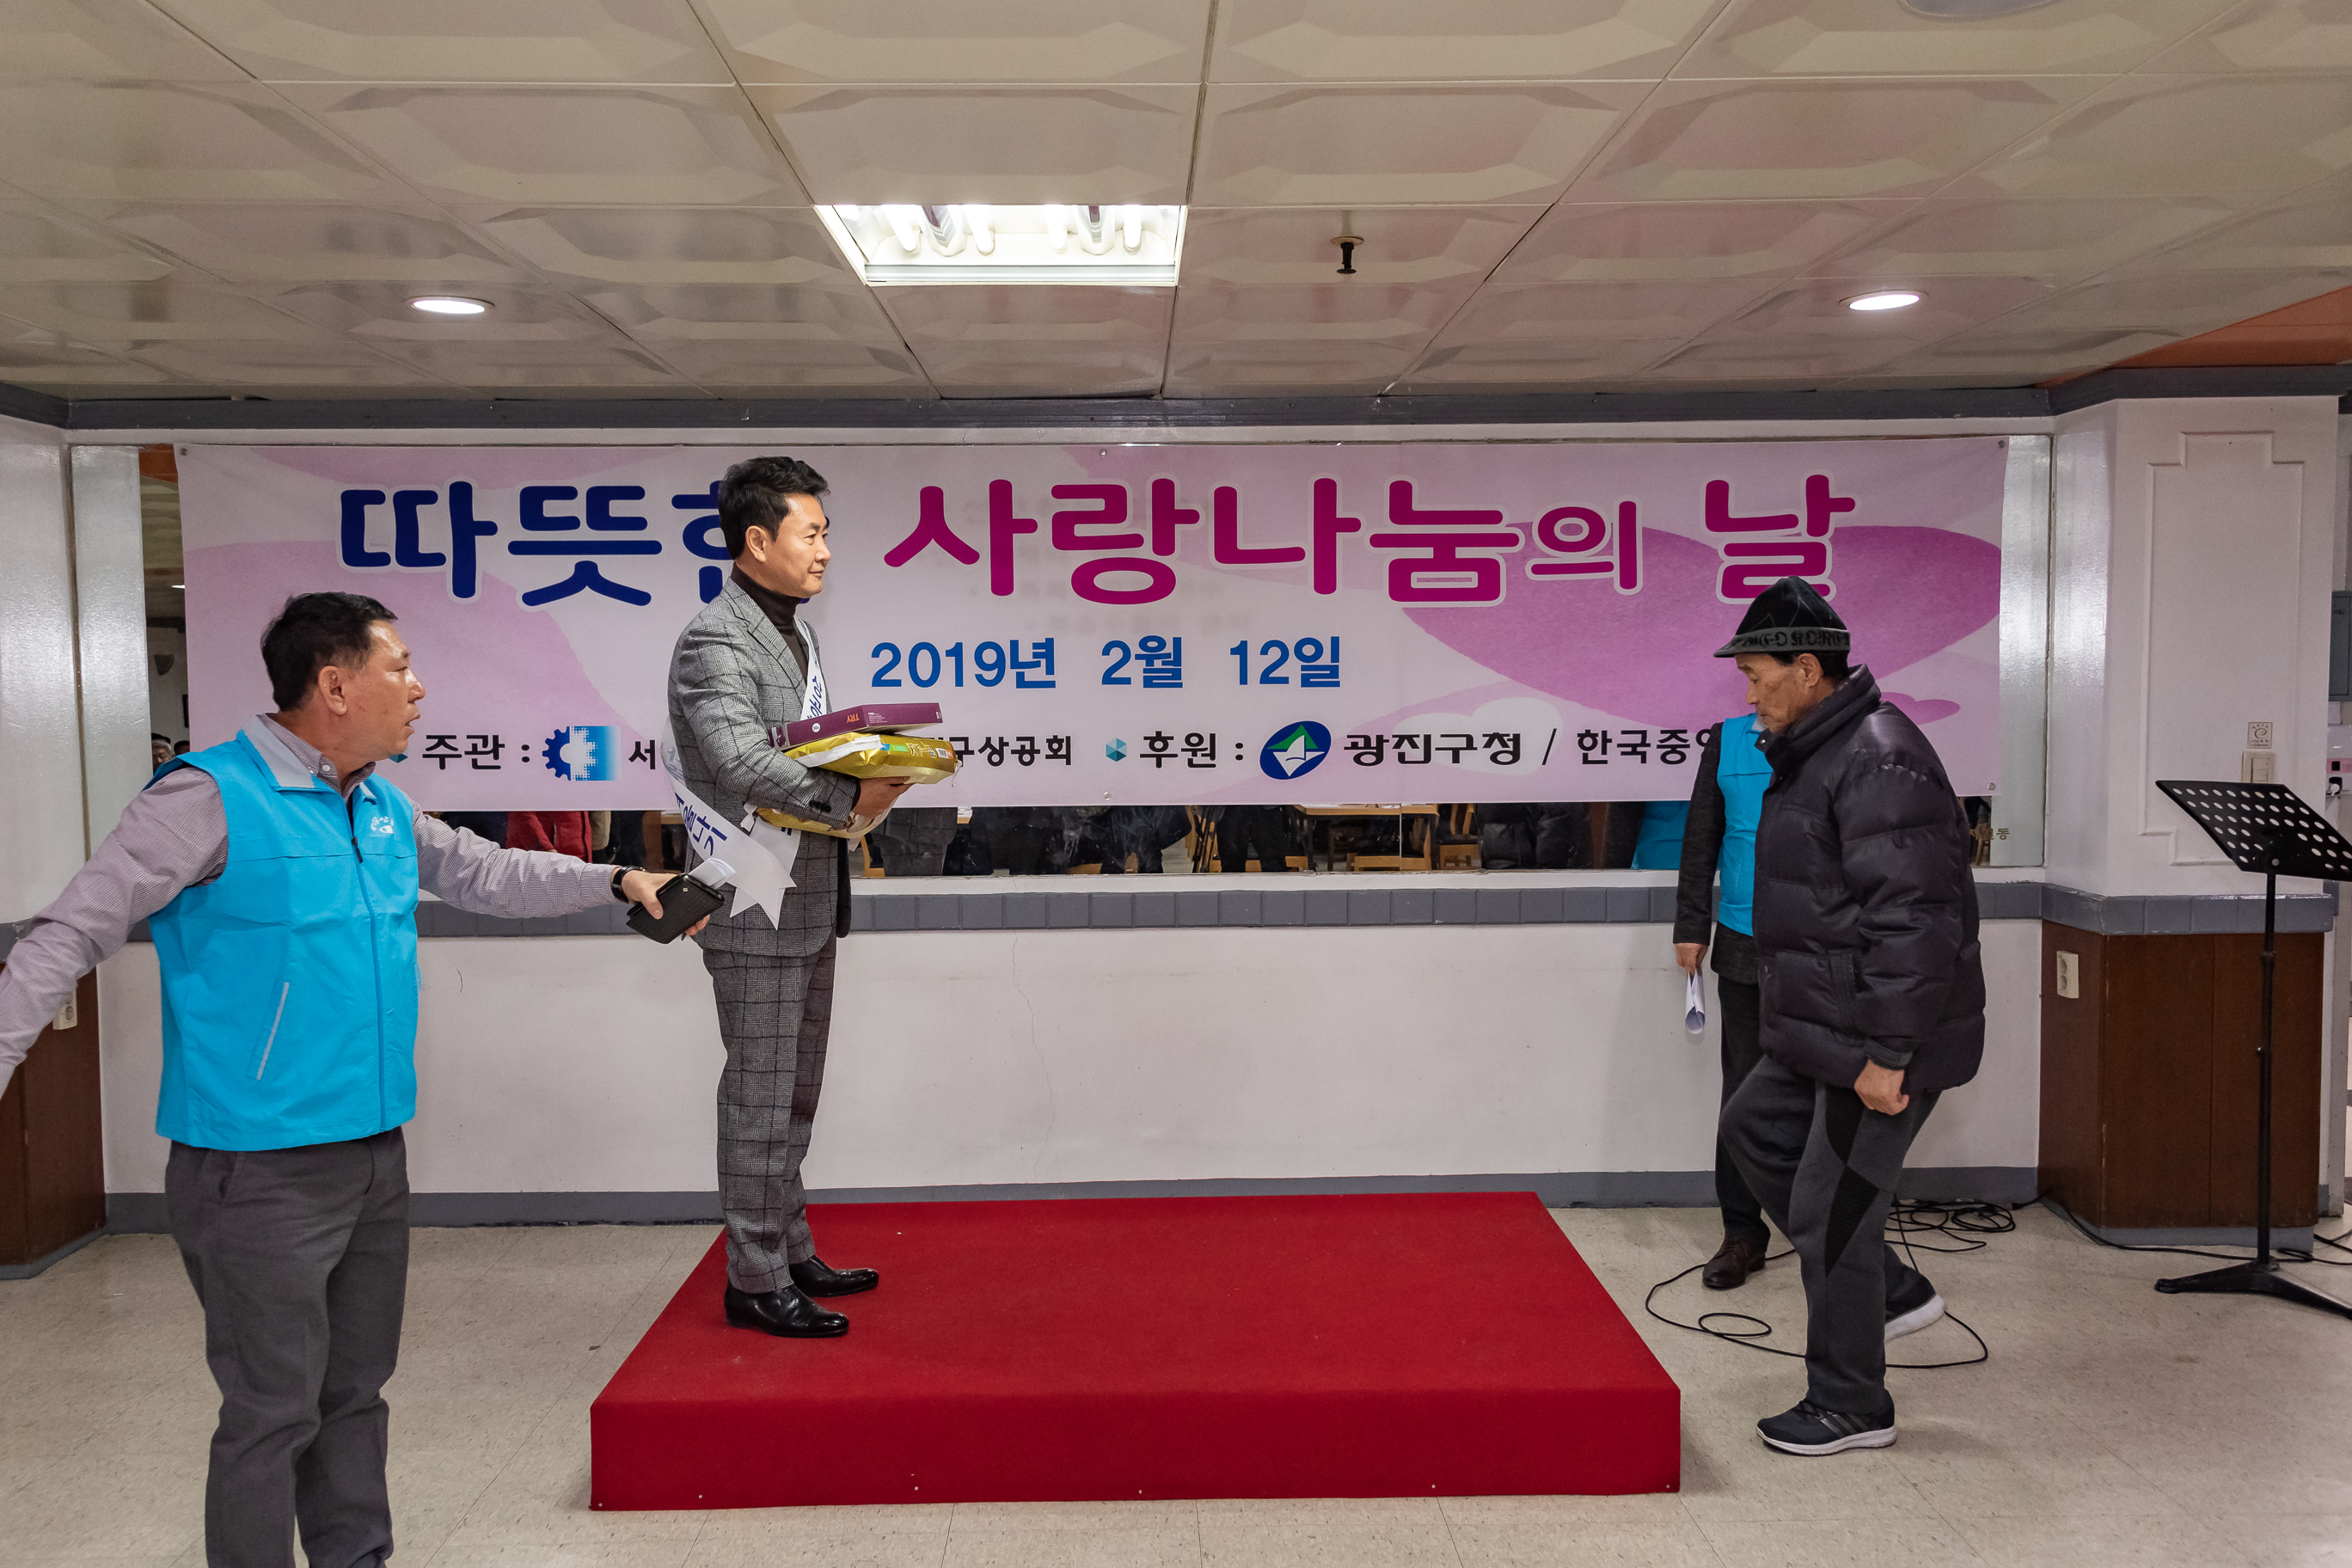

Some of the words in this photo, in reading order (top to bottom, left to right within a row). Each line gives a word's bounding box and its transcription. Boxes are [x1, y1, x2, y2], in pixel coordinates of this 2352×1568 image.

[884, 478, 1638, 605] 사랑나눔의
[1705, 475, 1856, 599] 날
[872, 638, 1056, 689] 2019년
[1101, 635, 1183, 689] 2월
[1230, 636, 1340, 688] 12일
[847, 713, 860, 724] TRY
[422, 734, 505, 770] 주관
[934, 735, 1071, 767] 구상공회
[1139, 731, 1216, 769] 후원
[1344, 732, 1521, 767] 광진구청
